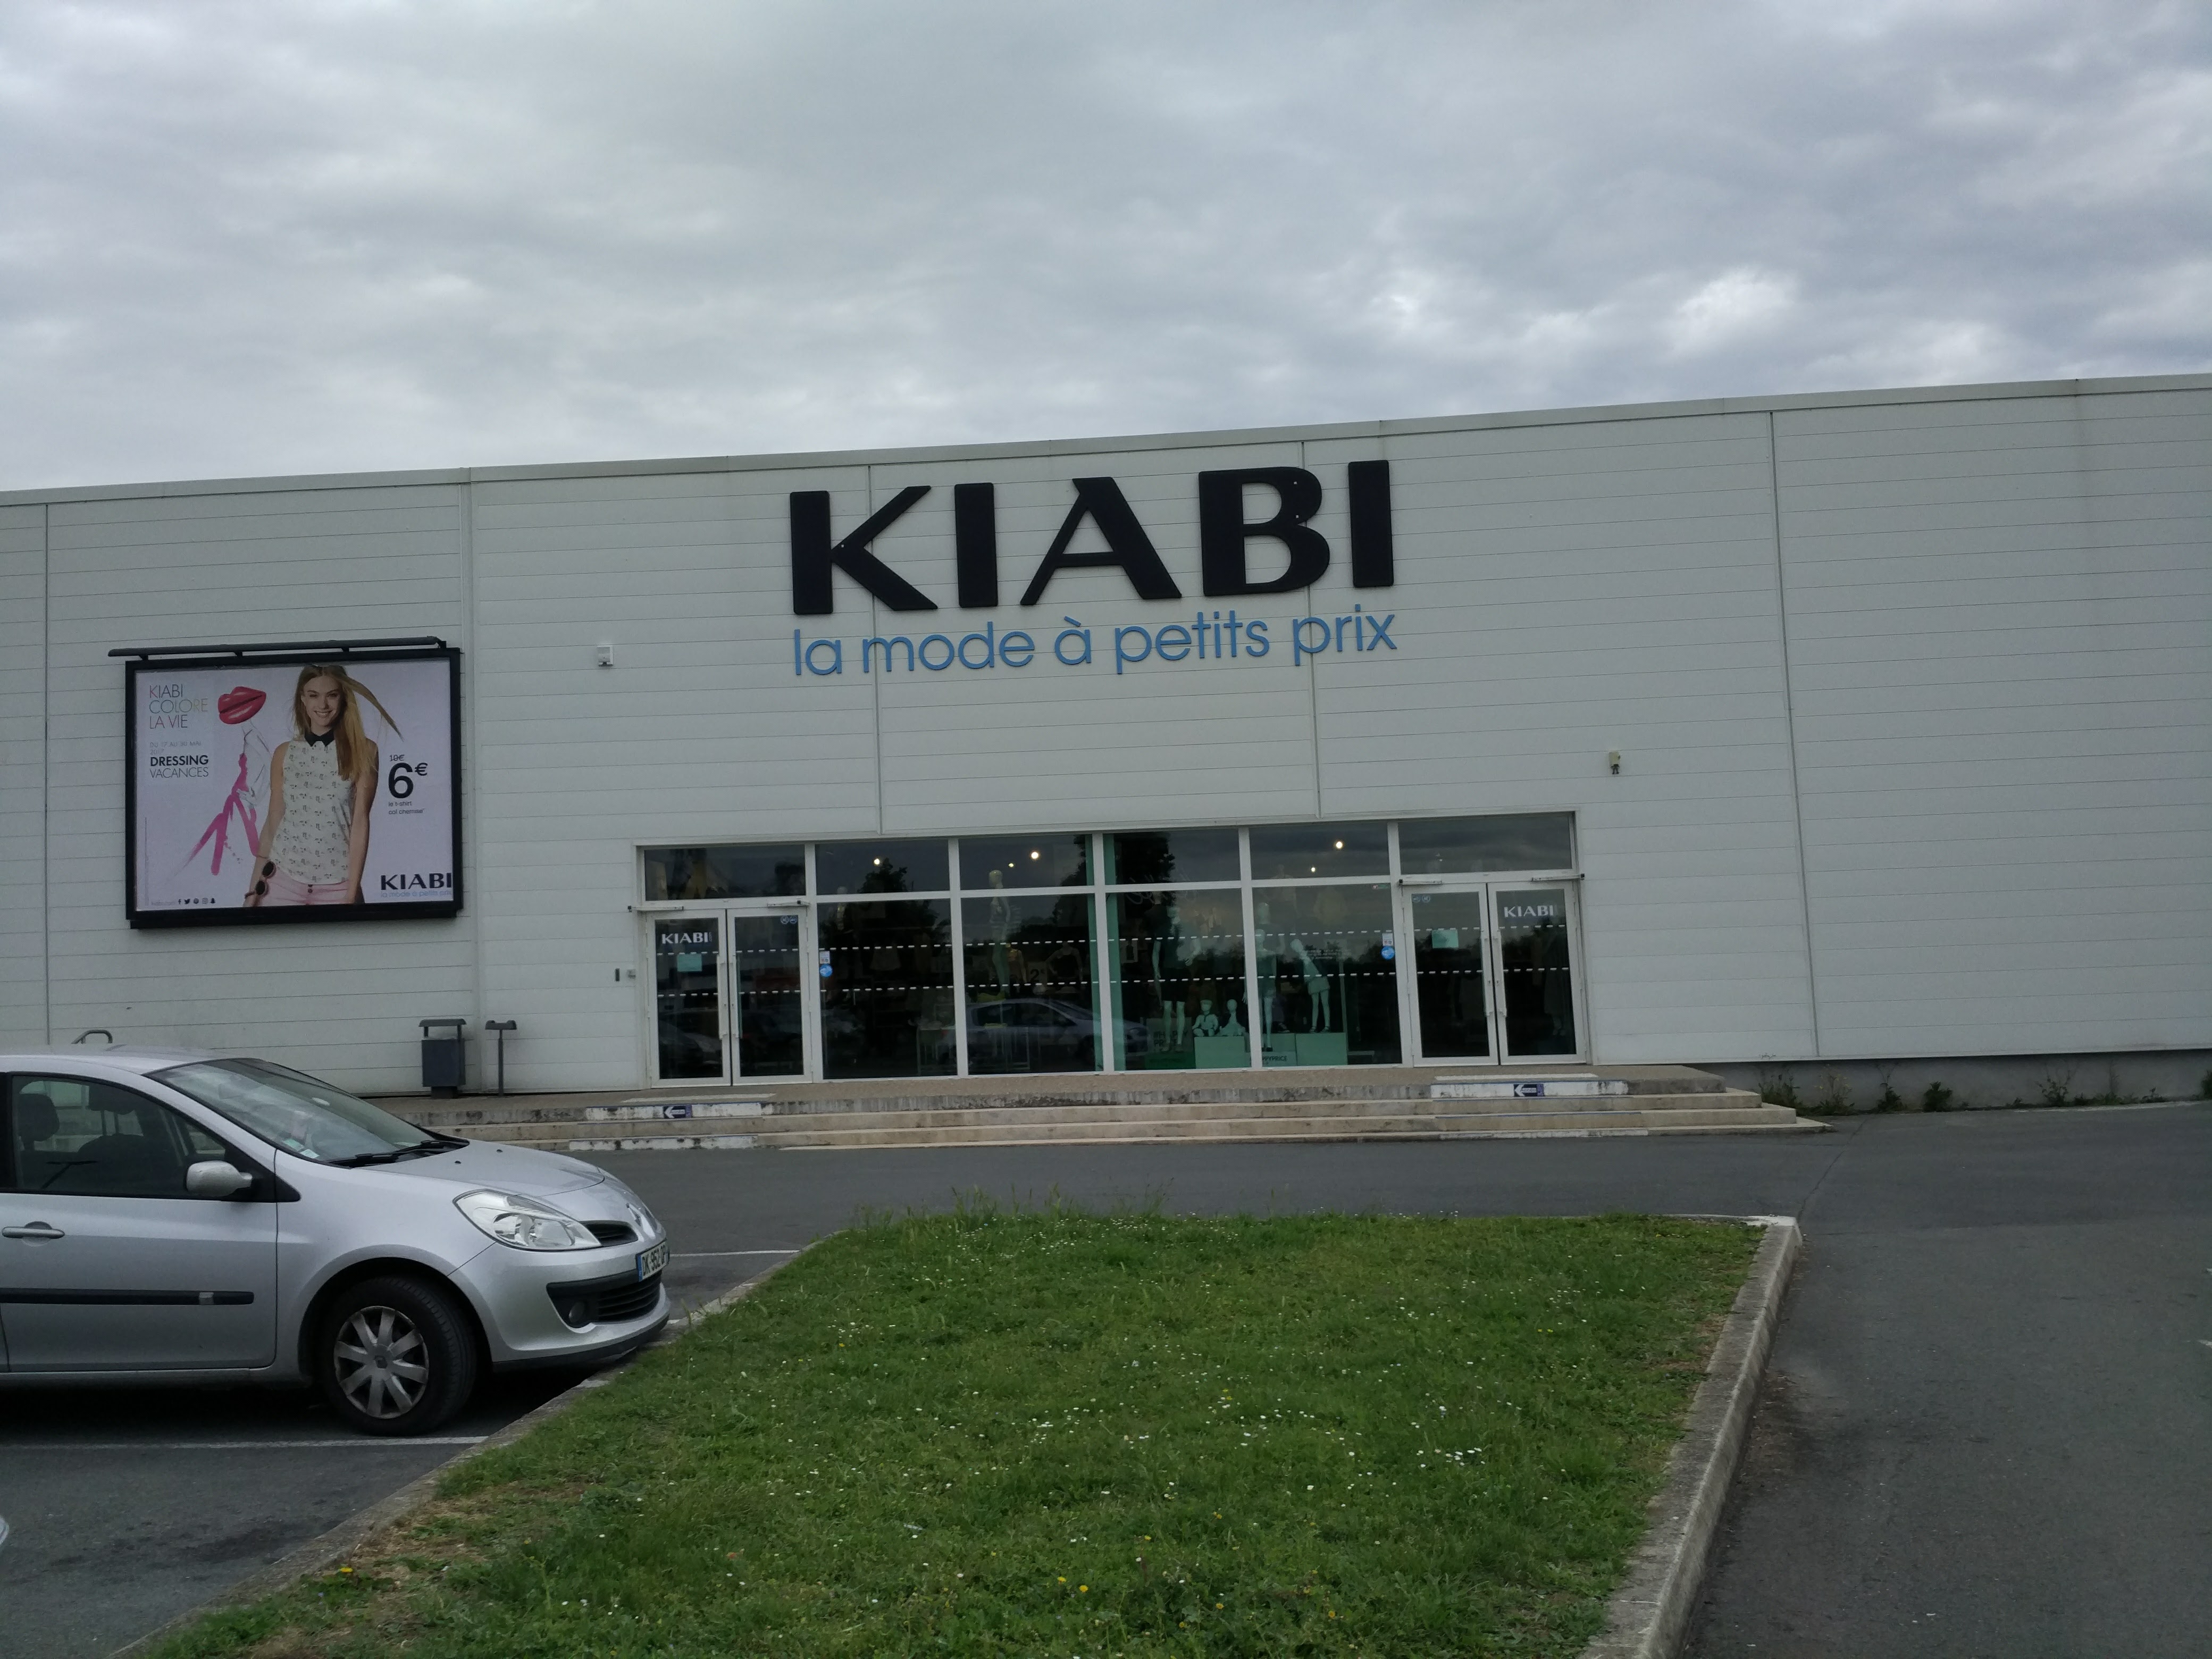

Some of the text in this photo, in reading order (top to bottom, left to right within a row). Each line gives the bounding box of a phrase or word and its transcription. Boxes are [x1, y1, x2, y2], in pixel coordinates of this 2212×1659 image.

[790, 459, 1394, 615] KIABI
[793, 604, 1397, 675] la mode à petits prix
[149, 684, 183, 698] KIABI
[149, 698, 208, 714] COLORE
[149, 714, 188, 729] LA VIE
[150, 755, 209, 766] DRESSING
[149, 767, 209, 778] VACANCES
[380, 872, 452, 891] KIABI
[1504, 904, 1554, 917] KIABI
[661, 932, 708, 944] KIABI
